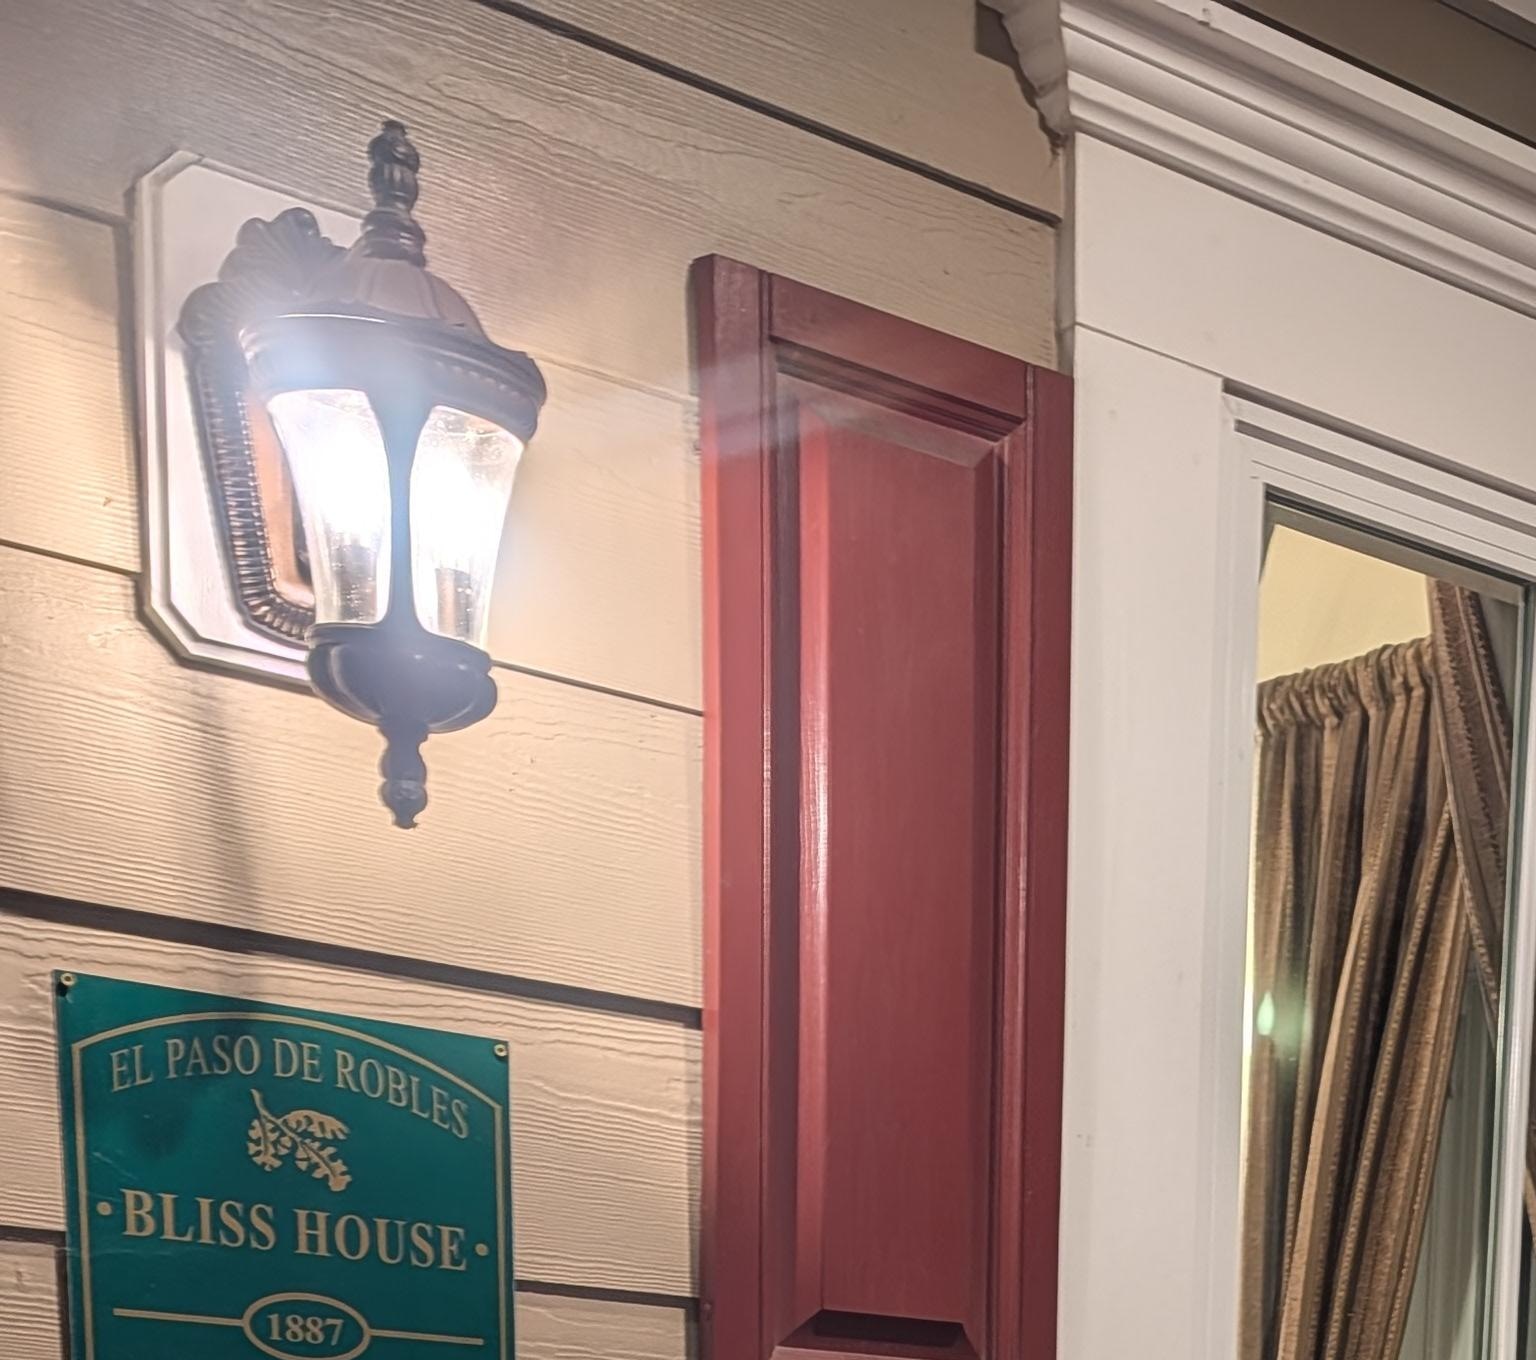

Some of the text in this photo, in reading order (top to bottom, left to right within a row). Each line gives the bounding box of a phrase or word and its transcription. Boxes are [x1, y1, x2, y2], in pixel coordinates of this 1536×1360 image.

[111, 1035, 470, 1139] EL PASO DE ROBLES
[120, 1188, 467, 1271] BLISS HOUSE
[267, 1313, 345, 1346] 1887
